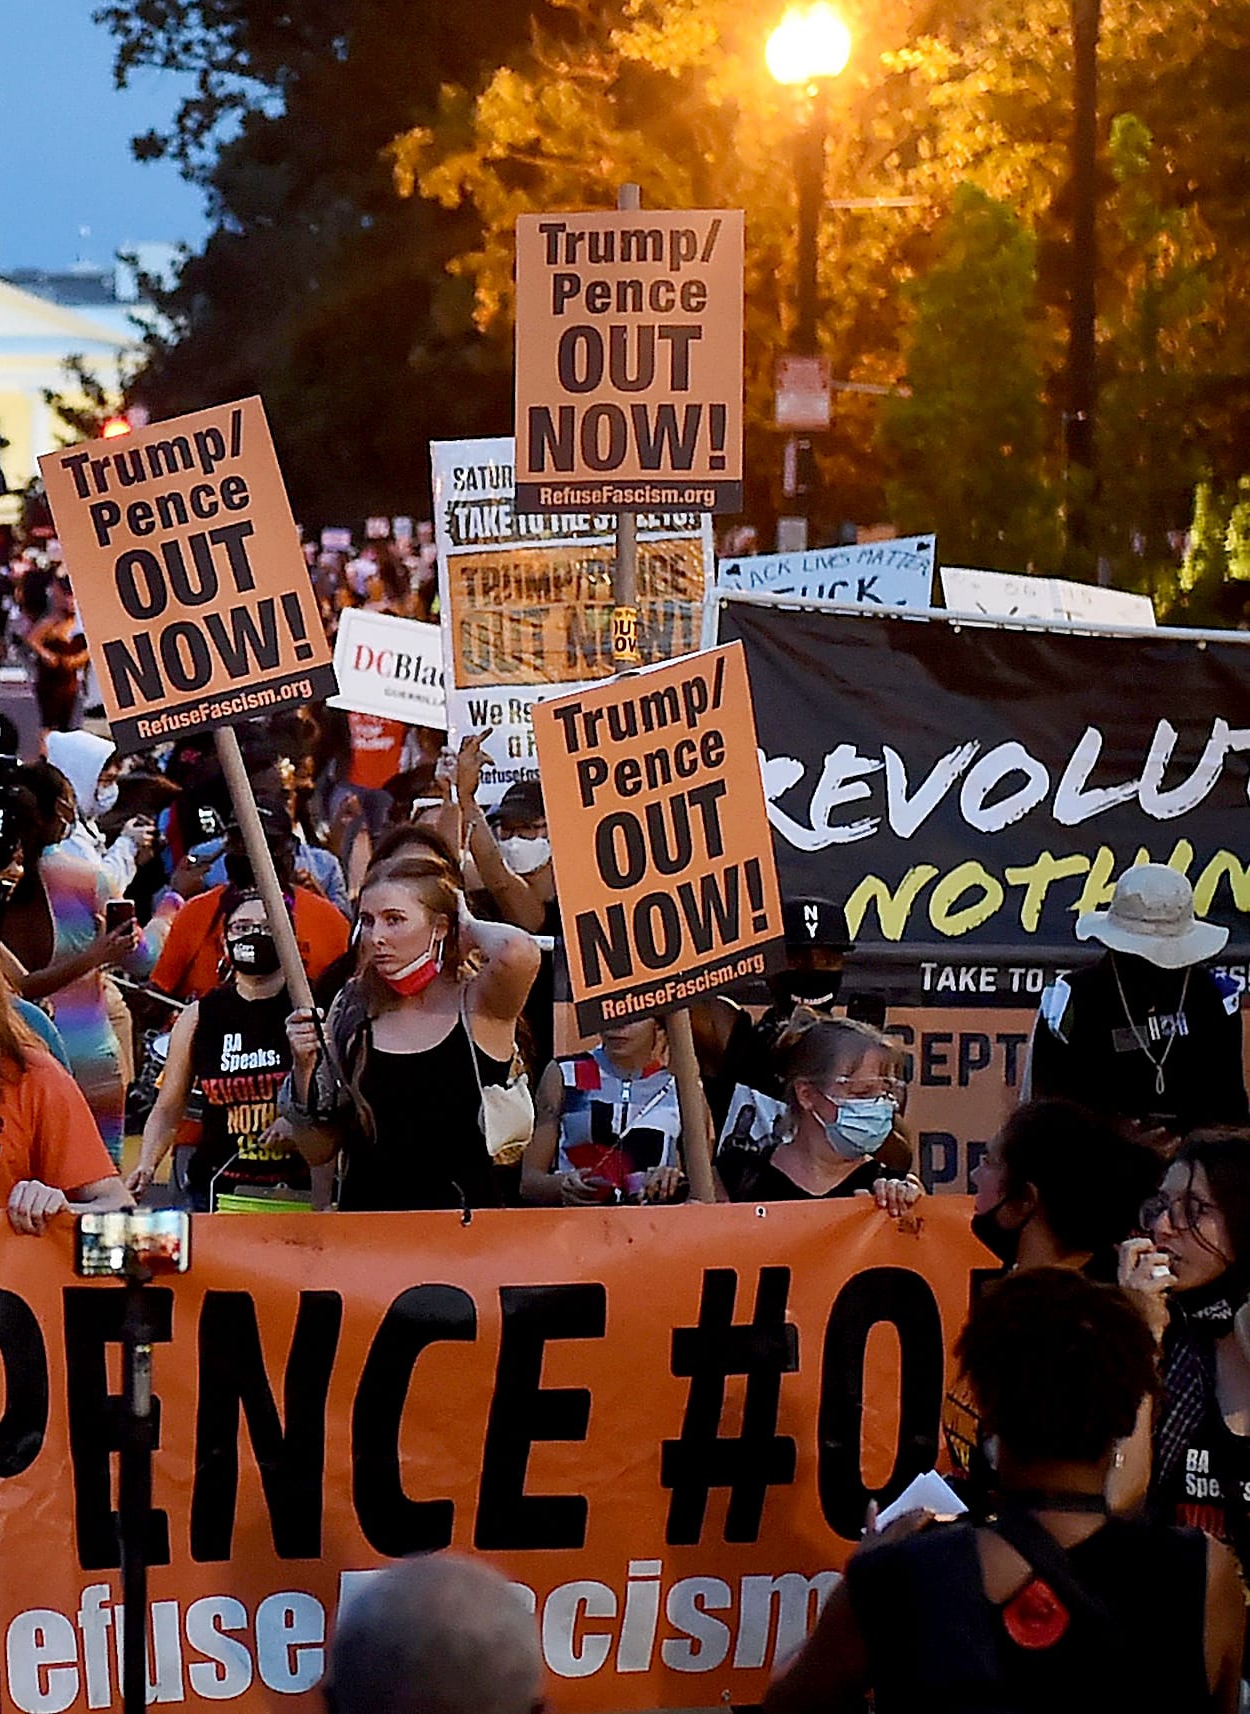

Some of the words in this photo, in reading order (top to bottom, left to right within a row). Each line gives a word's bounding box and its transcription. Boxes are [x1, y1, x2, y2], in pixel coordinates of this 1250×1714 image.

[540, 219, 721, 270] Trump/
[552, 273, 707, 315] Pence
[558, 325, 702, 393] OUT
[62, 409, 242, 499] Trump/
[528, 404, 726, 473] NOW!
[89, 474, 250, 547] Pence
[455, 503, 512, 540] TAKE
[540, 484, 715, 506] RefuseFascism.org
[114, 520, 255, 620] OUT
[802, 554, 851, 573] LIVES
[857, 550, 931, 577] MATTER
[103, 591, 314, 709] NOW!
[137, 677, 313, 739] RefuseFascism.org
[468, 699, 503, 727] We
[553, 656, 725, 754] Trump/
[577, 729, 726, 808] Pence
[595, 780, 727, 890] OUT
[575, 857, 769, 988] NOW!
[601, 952, 765, 1021] RefuseFascism.org
[921, 962, 999, 992] TAKE
[1009, 968, 1043, 993] TO
[220, 1048, 280, 1073] Speaks:
[223, 1033, 242, 1053] BA
[201, 1071, 286, 1105] REVOLUT
[227, 1102, 275, 1134] NOTH
[1186, 1449, 1209, 1473] BA
